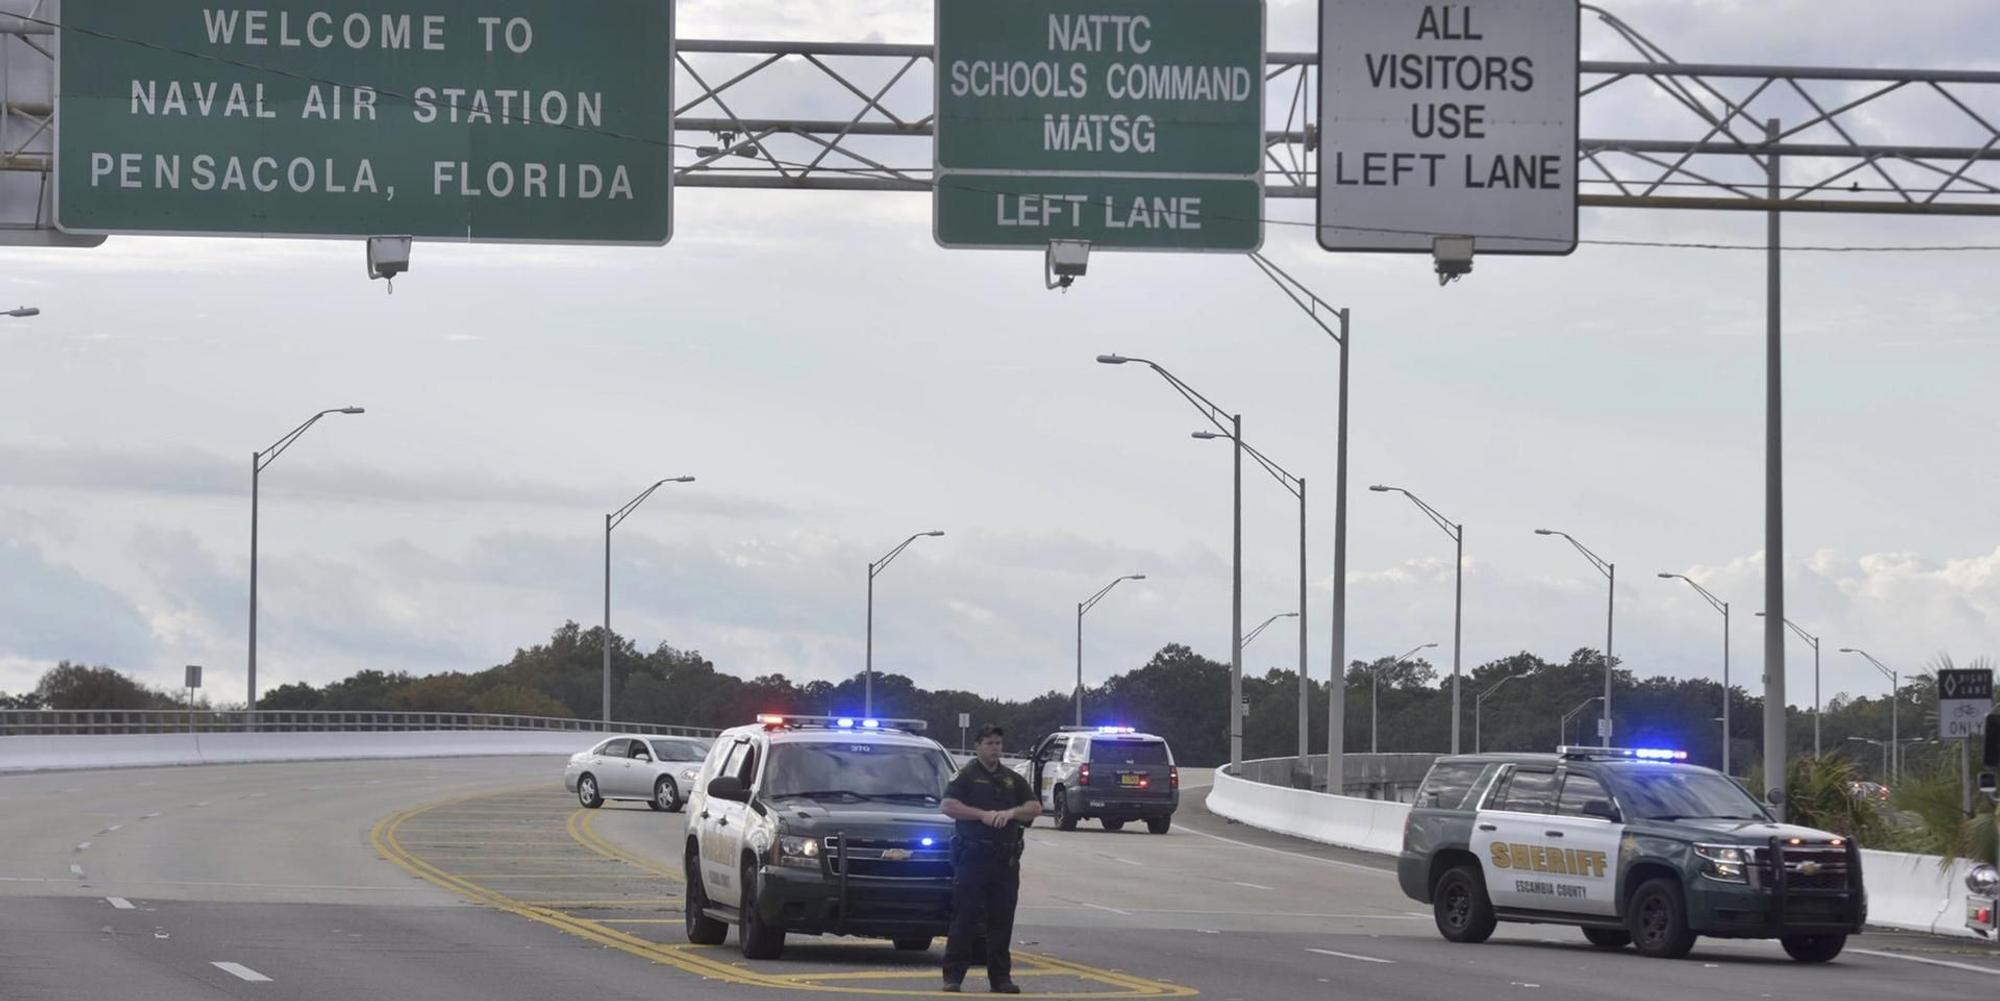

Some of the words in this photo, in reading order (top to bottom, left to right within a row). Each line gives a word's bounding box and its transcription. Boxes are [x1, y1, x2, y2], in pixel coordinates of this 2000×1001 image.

[203, 9, 445, 51] WELCOME
[477, 17, 533, 54] TO
[1048, 13, 1151, 54] NATTC
[1416, 5, 1483, 41] ALL
[951, 60, 1088, 99] SCHOOLS
[1106, 63, 1251, 101] COMMAND
[1365, 53, 1534, 92] VISITORS
[131, 79, 276, 118] NAVAL
[301, 84, 377, 121] AIR
[413, 87, 602, 127] STATION
[1411, 103, 1486, 139] USE
[1044, 113, 1155, 153] MATSG
[91, 152, 395, 200] PENSACOLA,
[433, 160, 634, 199] FLORIDA
[1336, 151, 1446, 188] LEFT
[1465, 154, 1561, 190] LANE
[997, 193, 1088, 227] LEFT
[1105, 195, 1201, 229] LANE
[1490, 841, 1608, 877] SHERIFF
[1516, 880, 1555, 895] ESCAMBIA
[1557, 884, 1587, 898] COUNTY
